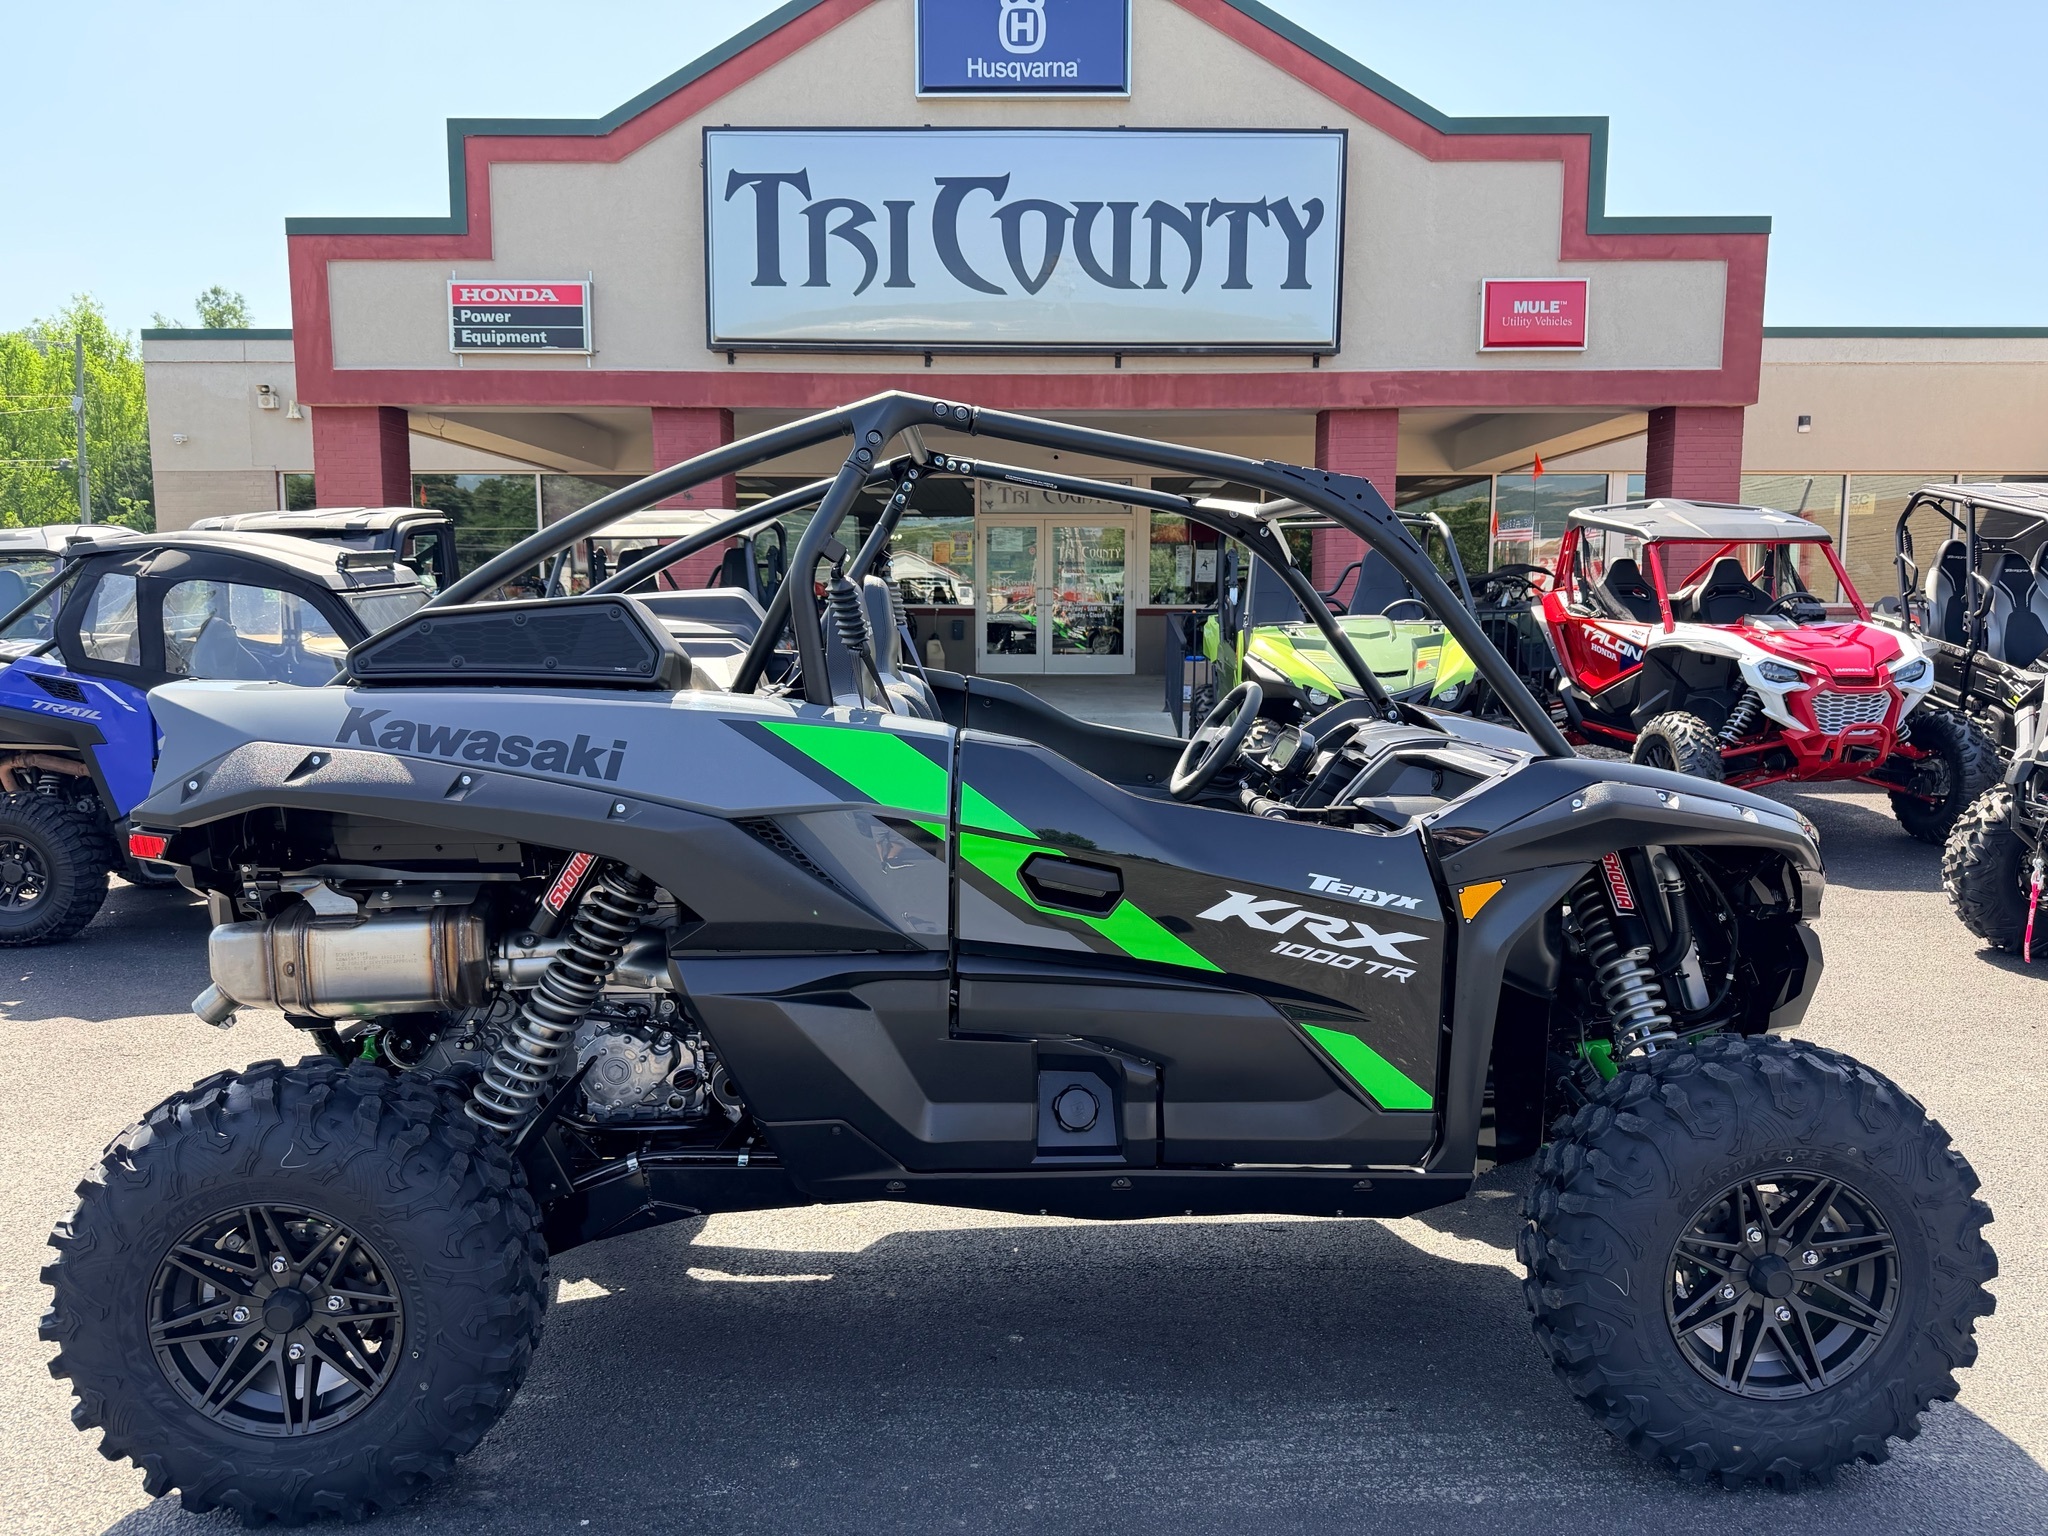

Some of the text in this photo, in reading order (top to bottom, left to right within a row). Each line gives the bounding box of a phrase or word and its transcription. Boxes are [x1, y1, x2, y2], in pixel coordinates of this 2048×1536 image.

[967, 57, 1079, 81] Husqvarna
[724, 167, 1325, 297] TRI COUNTY
[460, 288, 559, 302] HONDA
[460, 309, 511, 323] Power
[1502, 316, 1573, 329] Utility Vehicles
[461, 329, 547, 346] Equipment
[1581, 623, 1644, 662] TALON
[1590, 642, 1618, 662] HONDA
[31, 699, 103, 720] TRAIL
[335, 706, 628, 782] Kawasaki
[1601, 852, 1635, 910] SHOWA
[1196, 889, 1430, 965] KRX
[1269, 940, 1417, 984] 1000 TR
